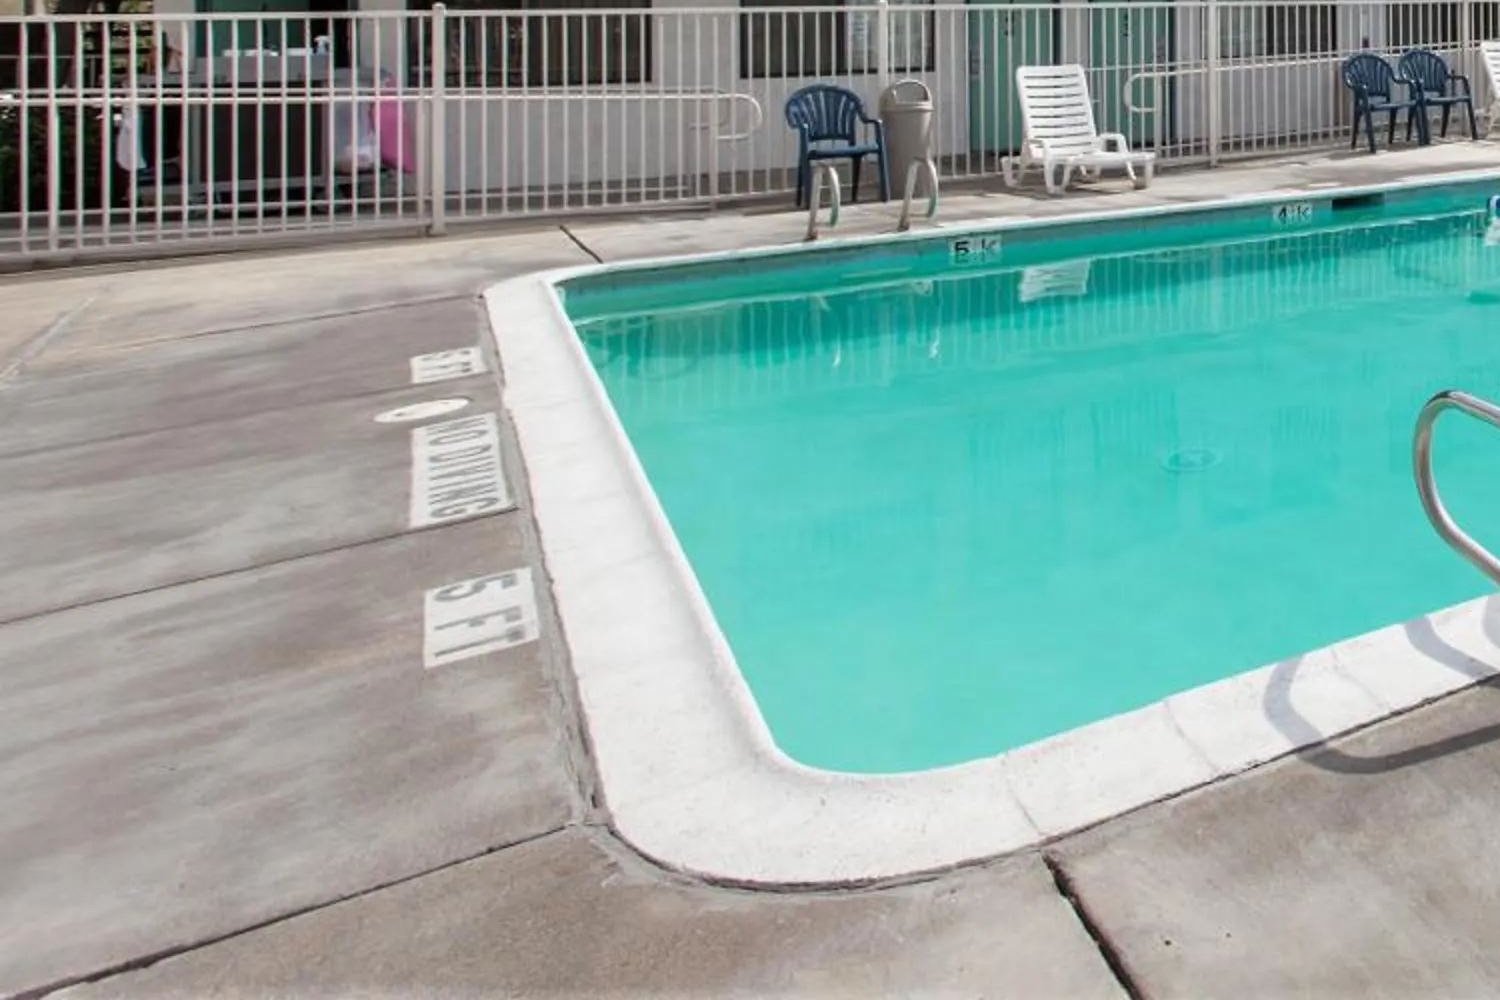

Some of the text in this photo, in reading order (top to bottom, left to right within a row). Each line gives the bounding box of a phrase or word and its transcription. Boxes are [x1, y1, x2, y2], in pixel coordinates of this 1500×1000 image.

[426, 416, 500, 518] NO DIVING
[434, 572, 526, 657] 5 FT
